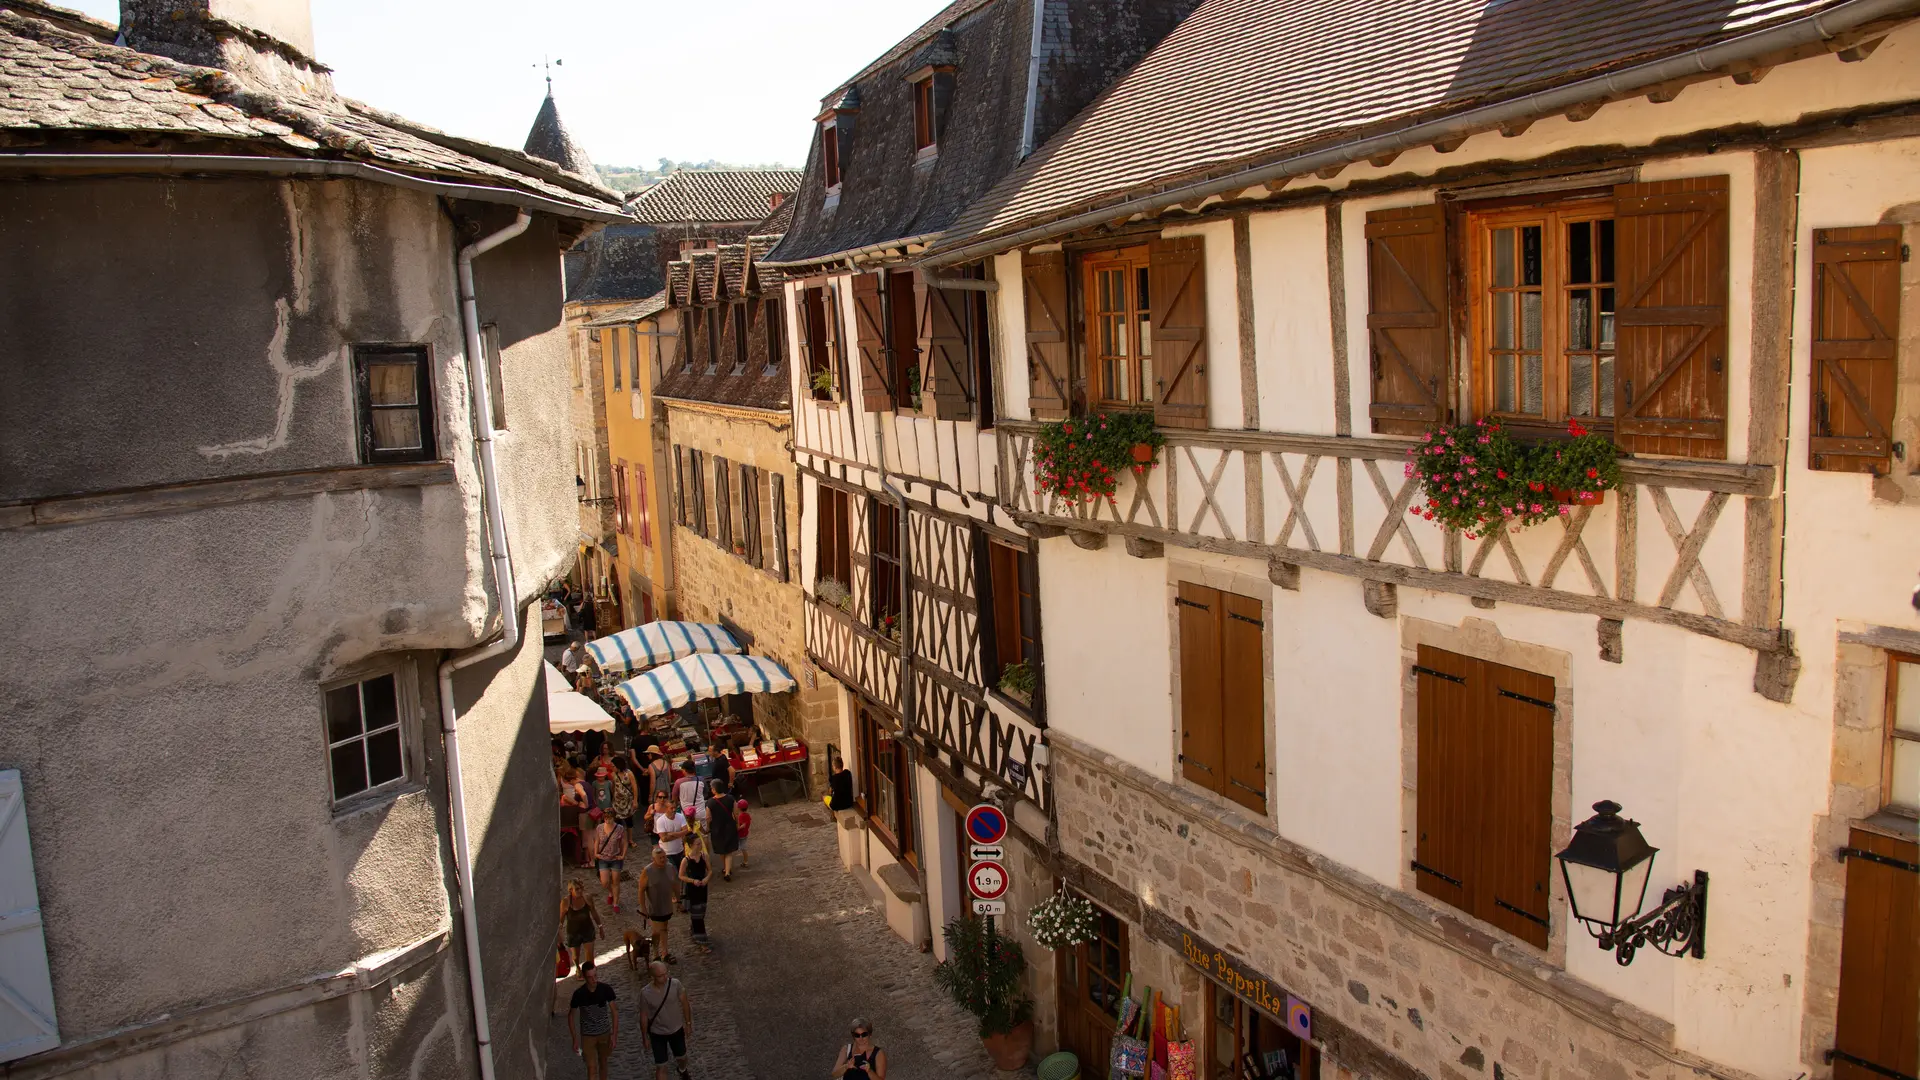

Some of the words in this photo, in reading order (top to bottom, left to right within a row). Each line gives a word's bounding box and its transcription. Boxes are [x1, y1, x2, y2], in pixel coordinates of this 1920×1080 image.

[976, 876, 992, 886] 1.9
[978, 904, 992, 912] 80
[1183, 933, 1210, 969] Rue
[1214, 952, 1280, 1015] Paprika
